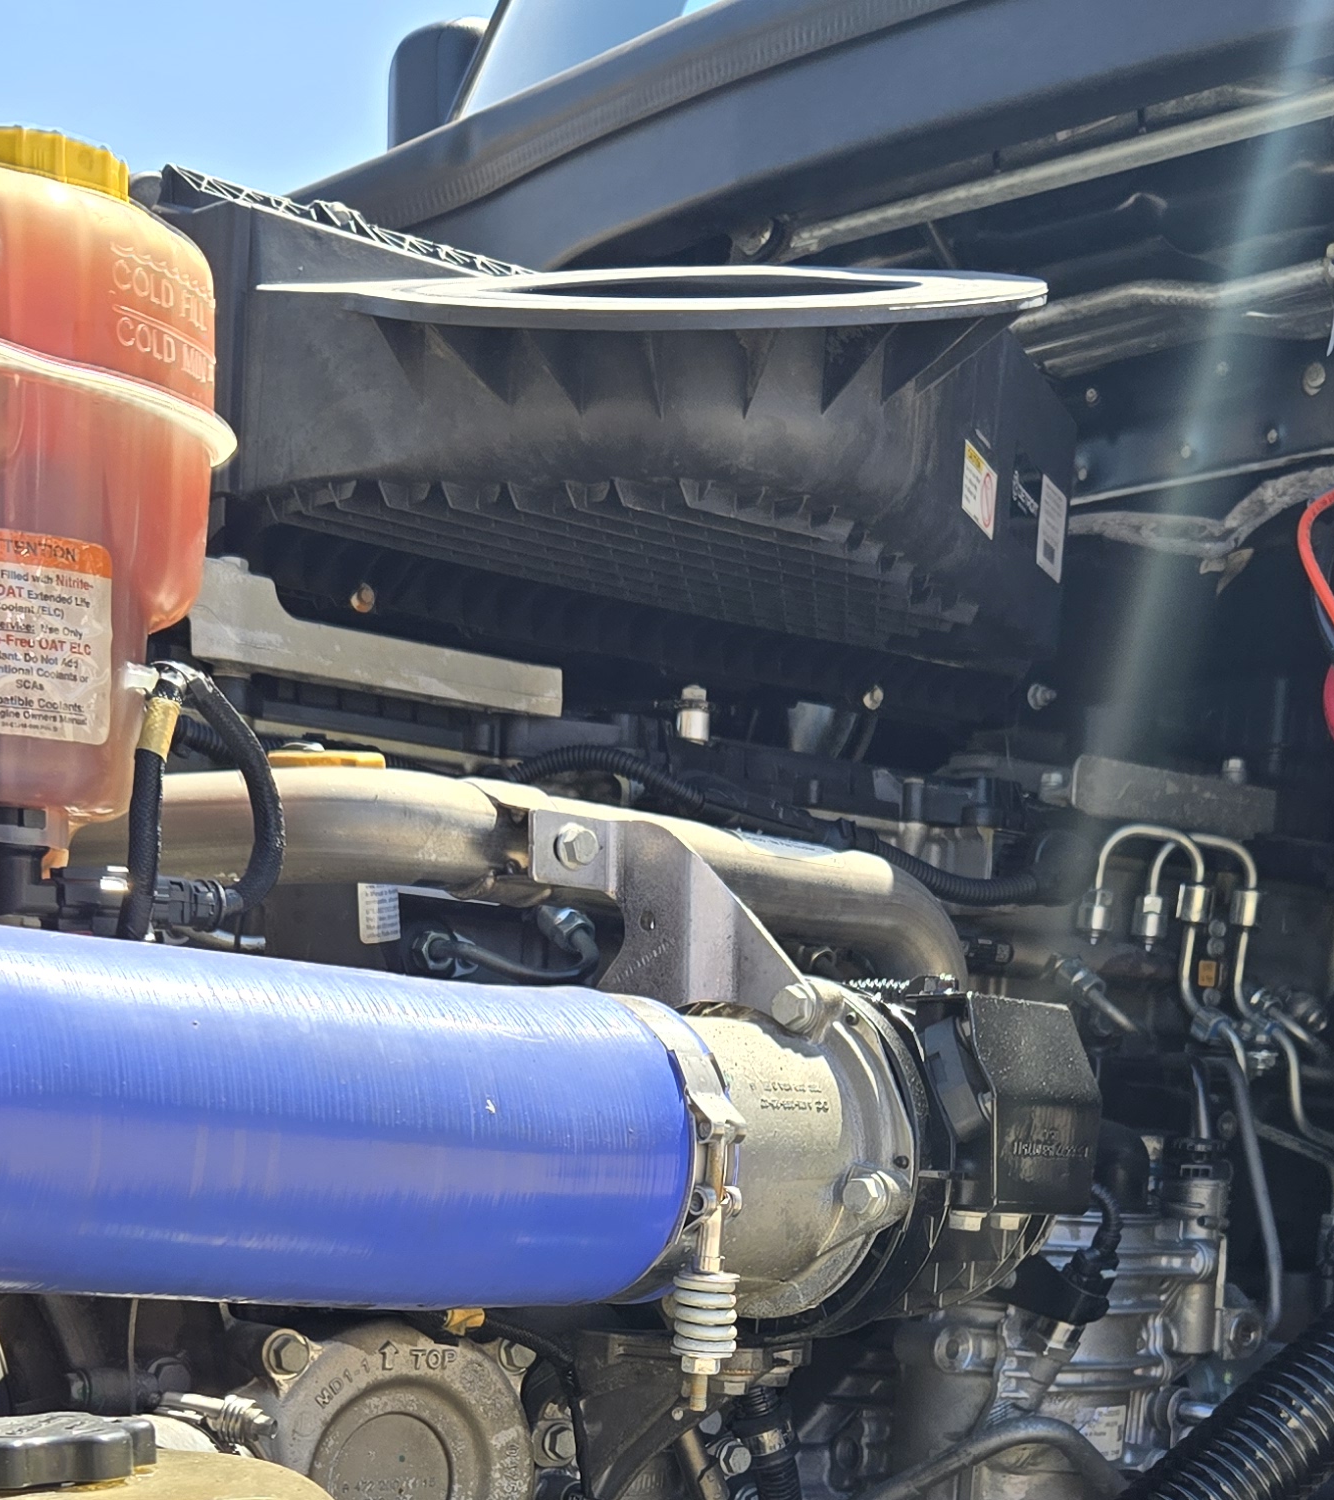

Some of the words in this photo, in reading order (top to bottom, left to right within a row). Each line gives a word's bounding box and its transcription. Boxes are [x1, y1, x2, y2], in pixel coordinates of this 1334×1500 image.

[112, 259, 174, 308] COLD
[179, 290, 207, 331] FILL
[116, 317, 175, 363] COLD
[1, 570, 29, 582] Filled
[56, 574, 94, 590] Nitrite-
[27, 590, 73, 605] Extended
[63, 628, 83, 640] Only
[39, 637, 66, 651] OAT
[70, 643, 91, 655] ELC
[24, 653, 38, 663] Do
[41, 656, 58, 665] Not
[37, 668, 77, 681] Coolants
[16, 680, 44, 691] SCAs
[410, 1349, 457, 1371] TOP
